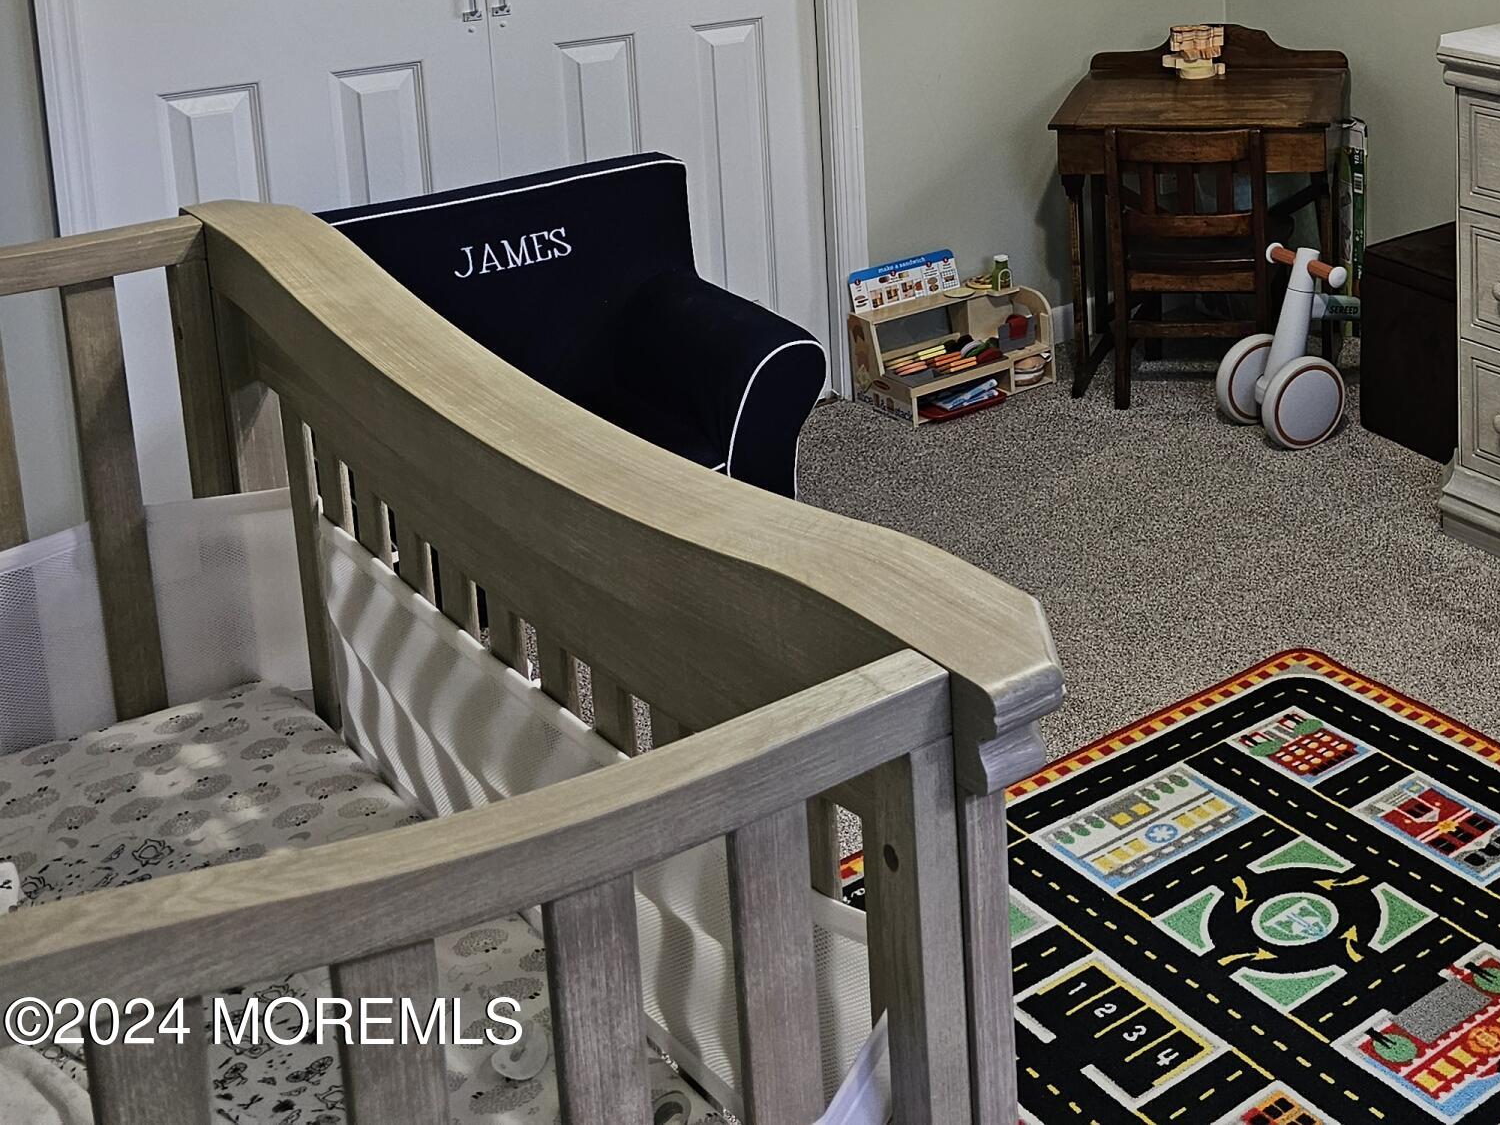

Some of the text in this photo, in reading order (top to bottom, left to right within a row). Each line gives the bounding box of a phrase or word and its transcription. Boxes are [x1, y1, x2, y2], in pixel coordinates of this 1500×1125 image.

[454, 227, 572, 278] JAMES
[1093, 1003, 1117, 1018] 2
[1122, 1025, 1147, 1042] 3
[1156, 1048, 1180, 1066] 4
